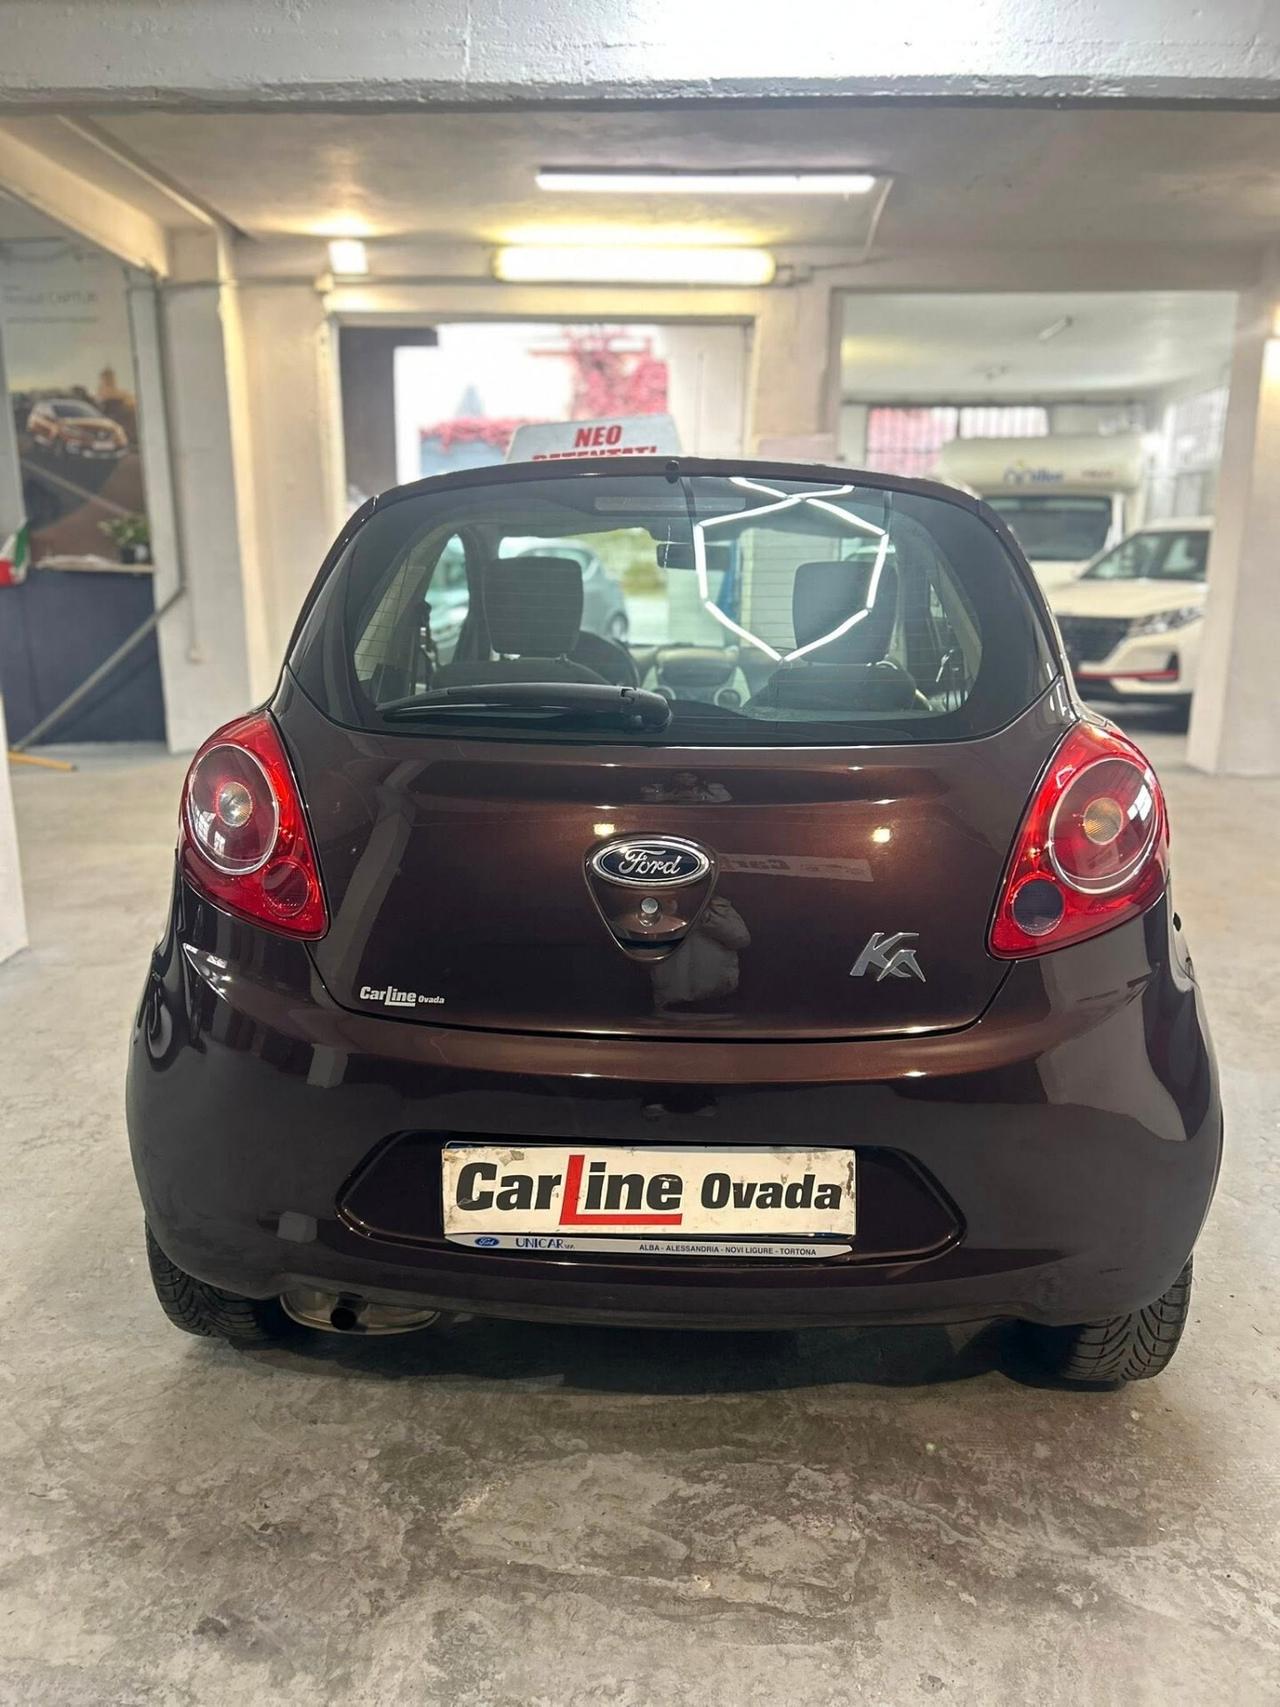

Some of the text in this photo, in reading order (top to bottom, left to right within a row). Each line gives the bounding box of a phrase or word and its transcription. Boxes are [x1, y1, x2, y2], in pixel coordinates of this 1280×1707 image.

[575, 425, 622, 448] NEO
[618, 849, 682, 876] Ford
[360, 986, 445, 1007] CarLine Ovada
[456, 1155, 842, 1225] CarLine Ovada
[515, 1238, 563, 1249] UNICAR
[666, 1245, 719, 1254] ALESSANDRIA
[745, 1246, 774, 1254] LIGURE
[780, 1248, 816, 1256] TORTONA
